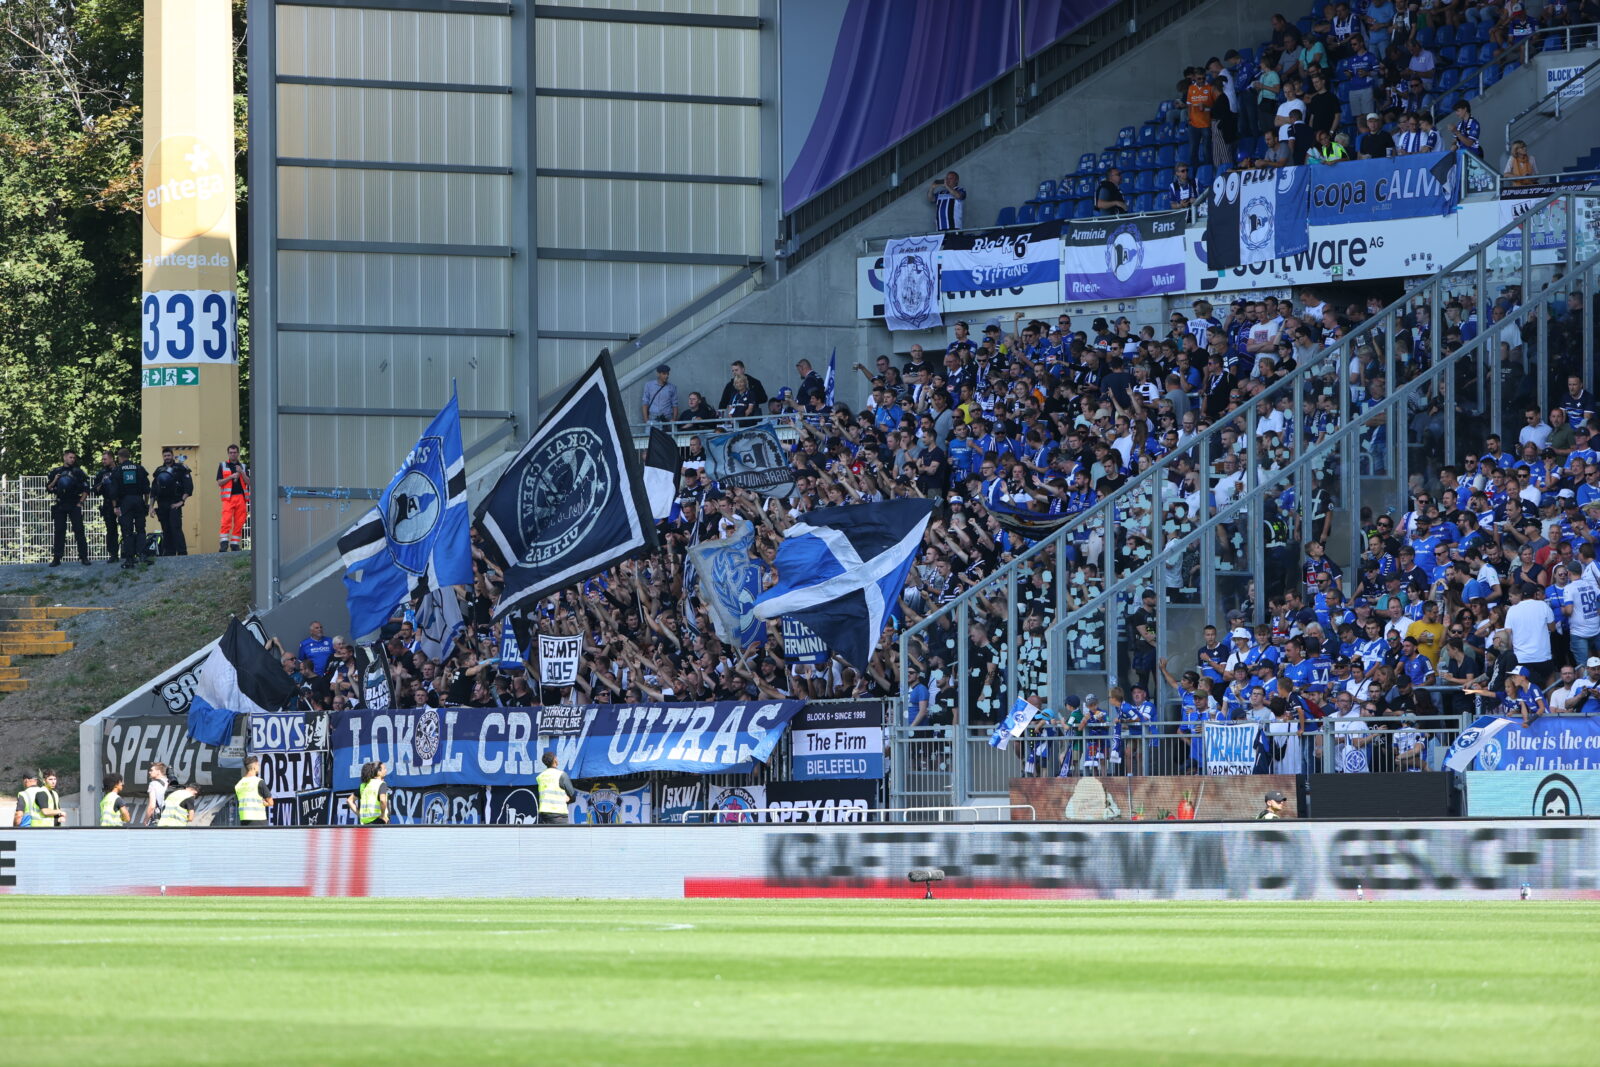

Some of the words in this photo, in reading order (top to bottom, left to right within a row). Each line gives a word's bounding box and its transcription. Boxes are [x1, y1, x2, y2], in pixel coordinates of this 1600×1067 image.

[1547, 69, 1572, 82] BLOCK
[1242, 168, 1275, 185] PLUS
[147, 174, 224, 207] entega
[1313, 180, 1366, 214] copa
[1071, 228, 1107, 241] Arminia
[1152, 221, 1176, 234] Fans
[971, 236, 1013, 255] Block
[1369, 236, 1384, 250] AG
[154, 252, 230, 269] entega.de
[1152, 272, 1176, 287] Main
[806, 712, 826, 721] BLOCK
[834, 711, 852, 720] SINCE
[853, 711, 866, 719] 1998
[252, 716, 305, 749] BOYS
[478, 708, 599, 779] CREW
[607, 702, 784, 765] ULTRAS
[806, 733, 831, 751] The
[835, 731, 866, 750] Firm
[1506, 729, 1542, 750] Blue
[1543, 731, 1558, 750] is
[1560, 729, 1583, 750] the
[105, 724, 214, 787] SPENGE
[260, 751, 315, 794] ORTA
[806, 759, 867, 775] BIELEFELD
